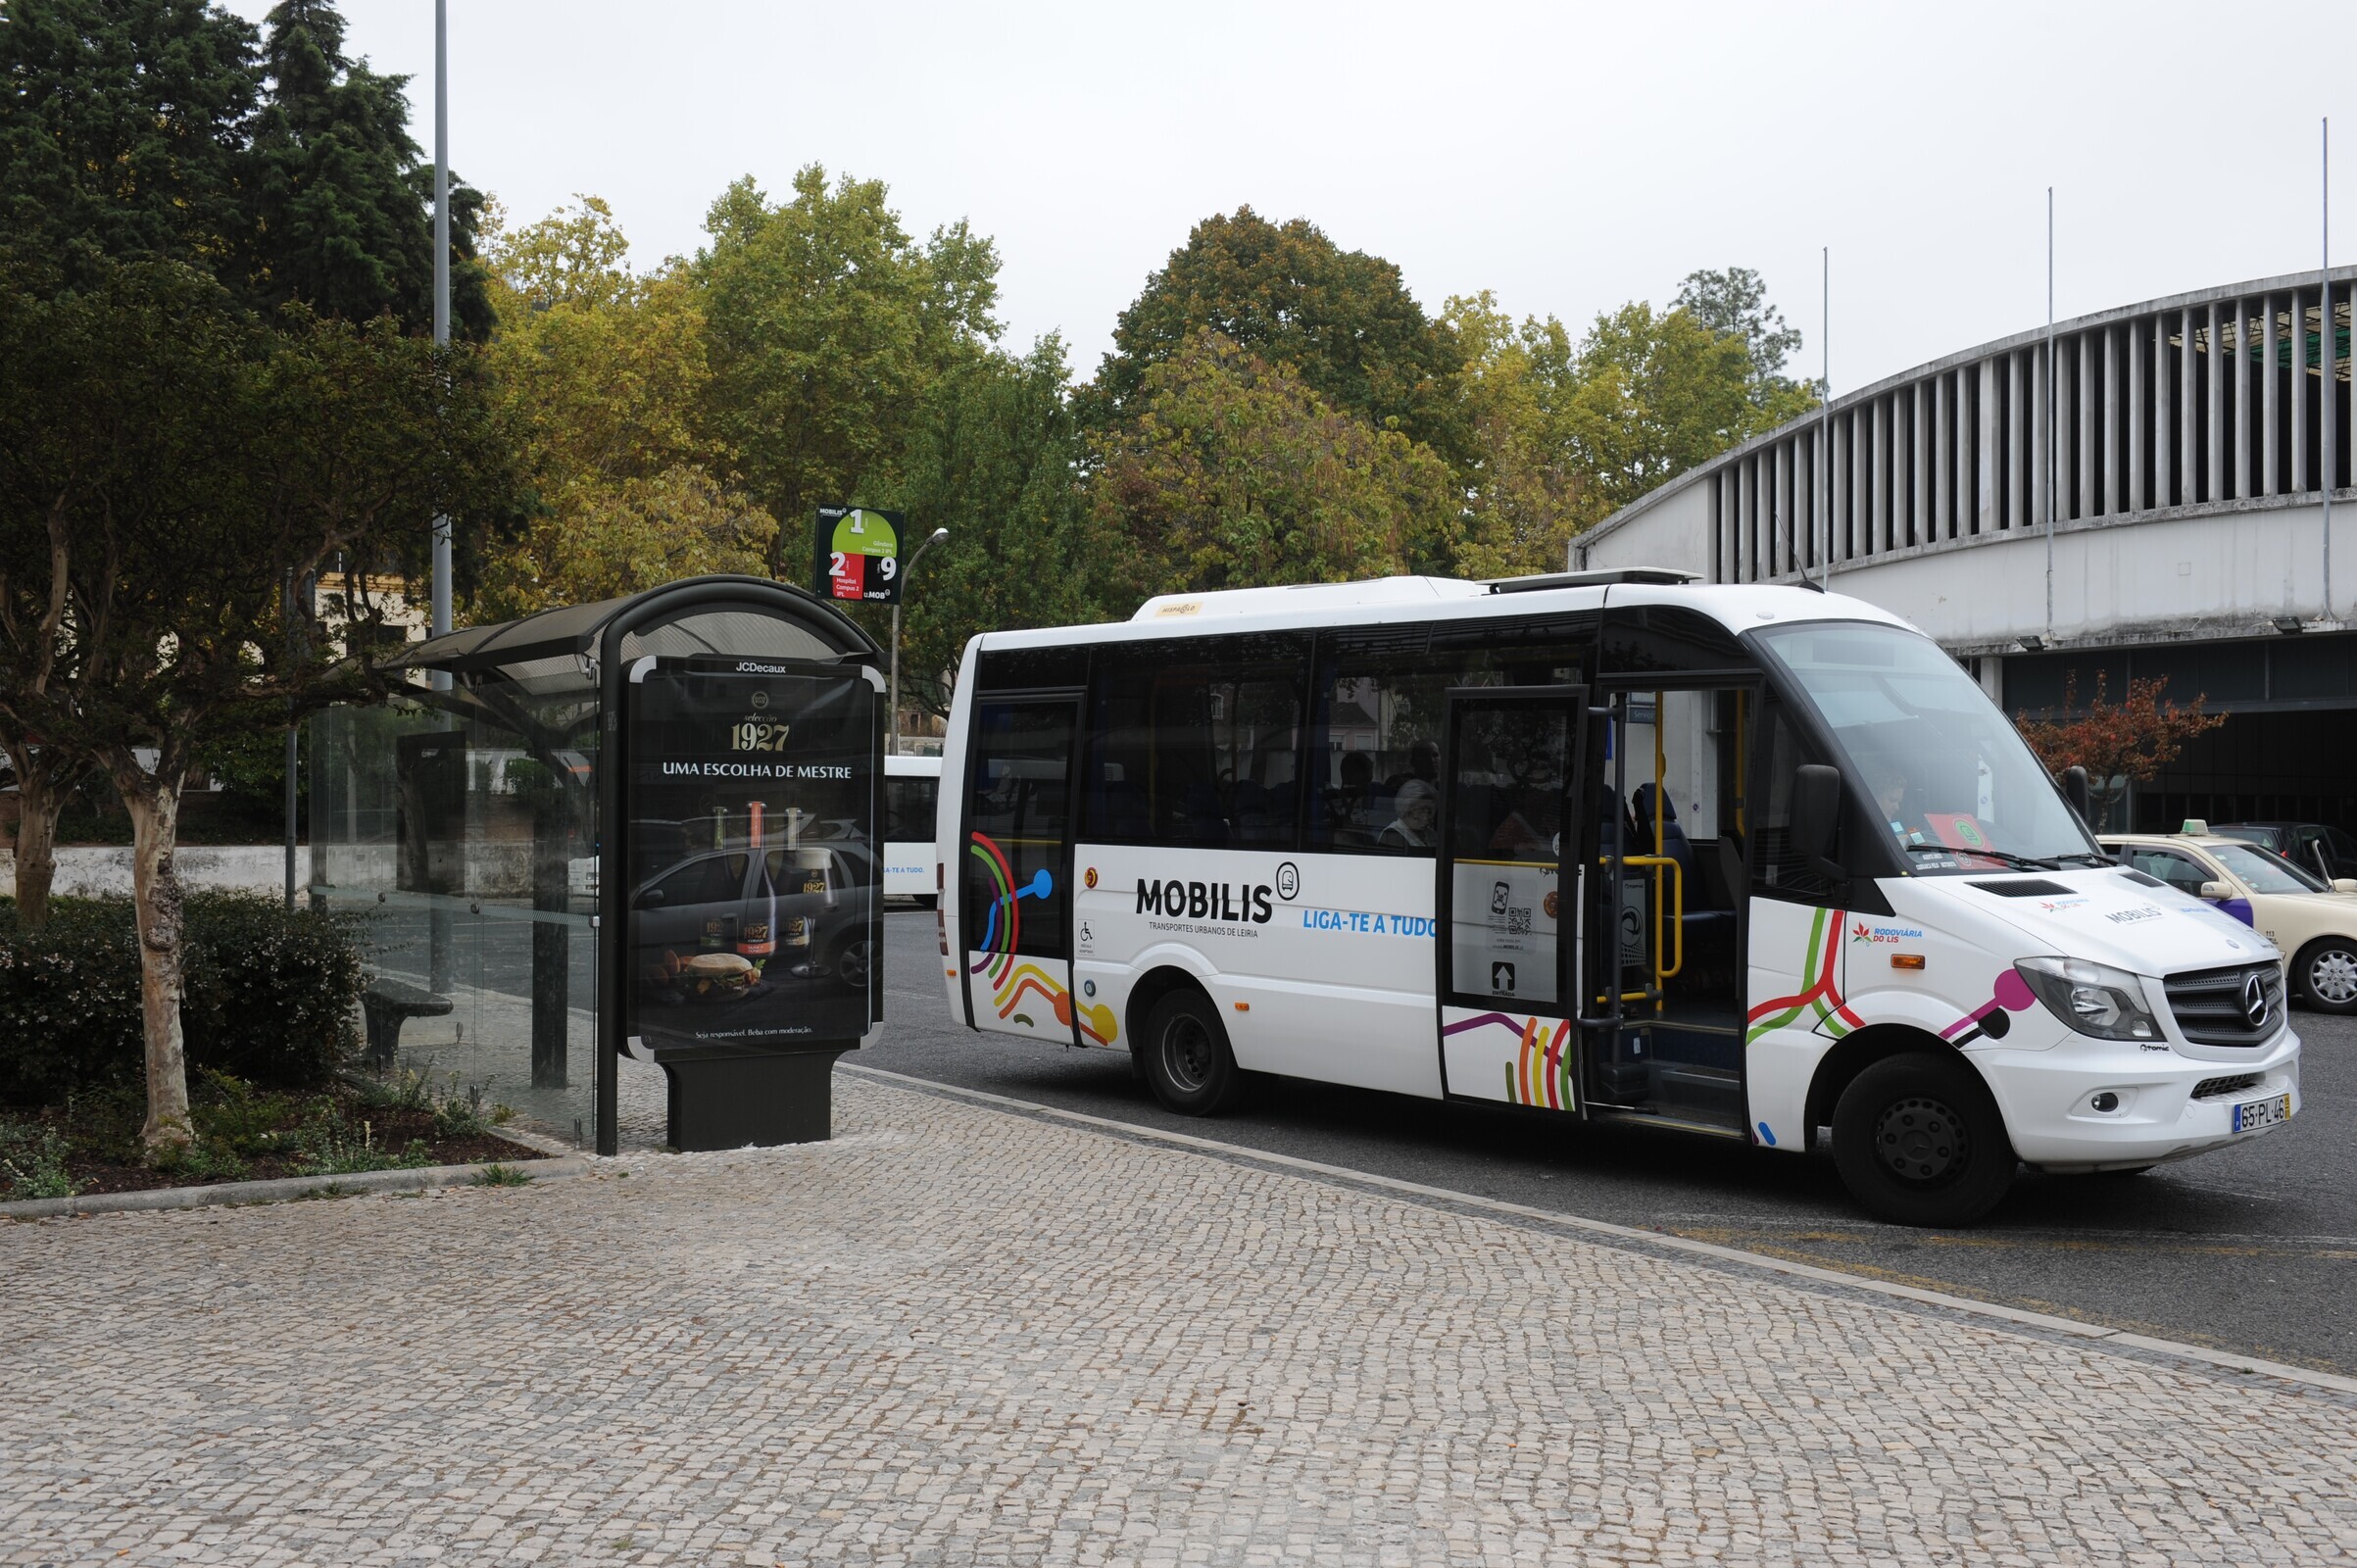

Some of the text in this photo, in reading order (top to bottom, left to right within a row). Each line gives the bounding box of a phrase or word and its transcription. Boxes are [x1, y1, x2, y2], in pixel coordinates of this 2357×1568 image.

[850, 509, 864, 534] 1
[828, 551, 846, 576] 2
[881, 557, 897, 581] 9
[735, 662, 786, 674] JCDecaux
[730, 722, 790, 752] 1927
[663, 761, 852, 779] UMA ESCOLHA DE MESTRE
[803, 882, 825, 894] 1927
[1136, 878, 1273, 924] MOBILIS
[1302, 909, 1370, 933] LIGA-TE
[1372, 914, 1386, 934] A
[2104, 907, 2163, 924] MOBILIS
[1149, 921, 1258, 938] TRANSPORTES URBANOS DE LEIRIA
[1874, 927, 1923, 938] RODOVIÁRIA
[1492, 989, 1515, 998] ENTRADA
[695, 1030, 709, 1040] Seja
[710, 1028, 746, 1039] responsável.
[748, 1028, 763, 1037] Beba
[778, 1025, 813, 1036] moderação.
